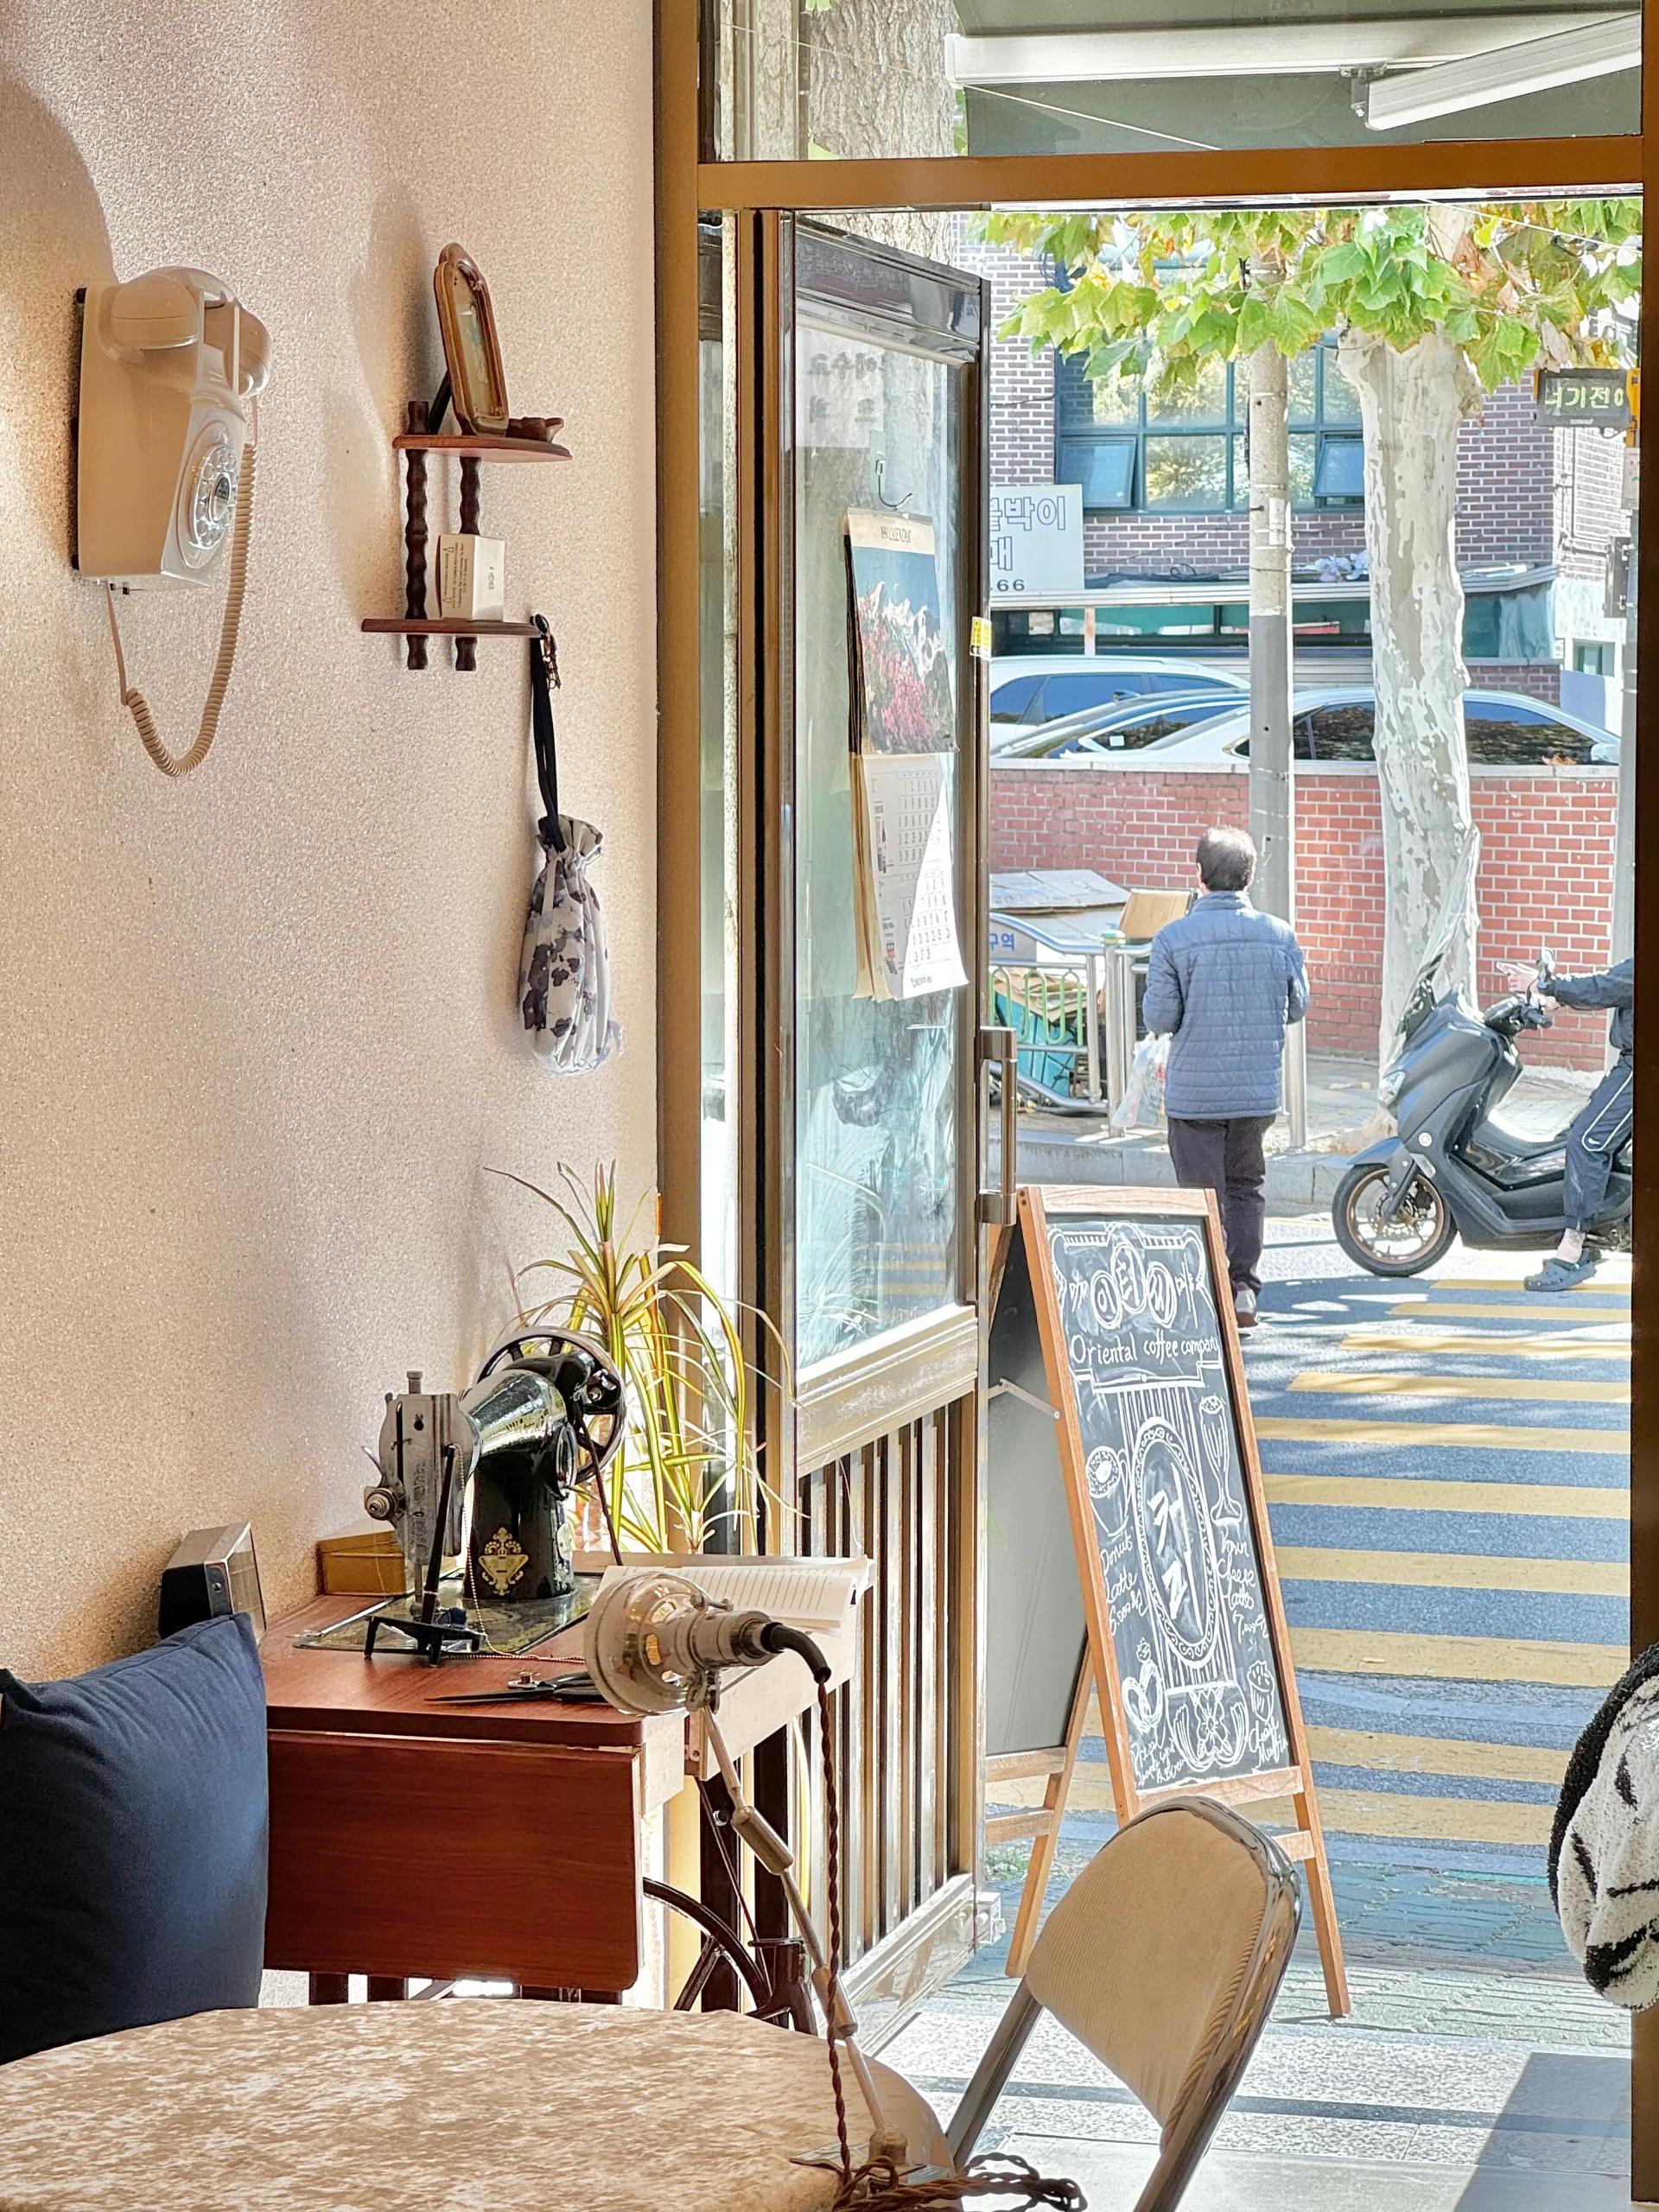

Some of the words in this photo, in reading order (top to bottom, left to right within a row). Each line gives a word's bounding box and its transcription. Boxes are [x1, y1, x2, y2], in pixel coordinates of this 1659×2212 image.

[990, 579, 1026, 592] 66
[1071, 1332, 1138, 1366] Oriental
[1144, 1327, 1179, 1365] coffee
[1105, 1566, 1138, 1604] Latte
